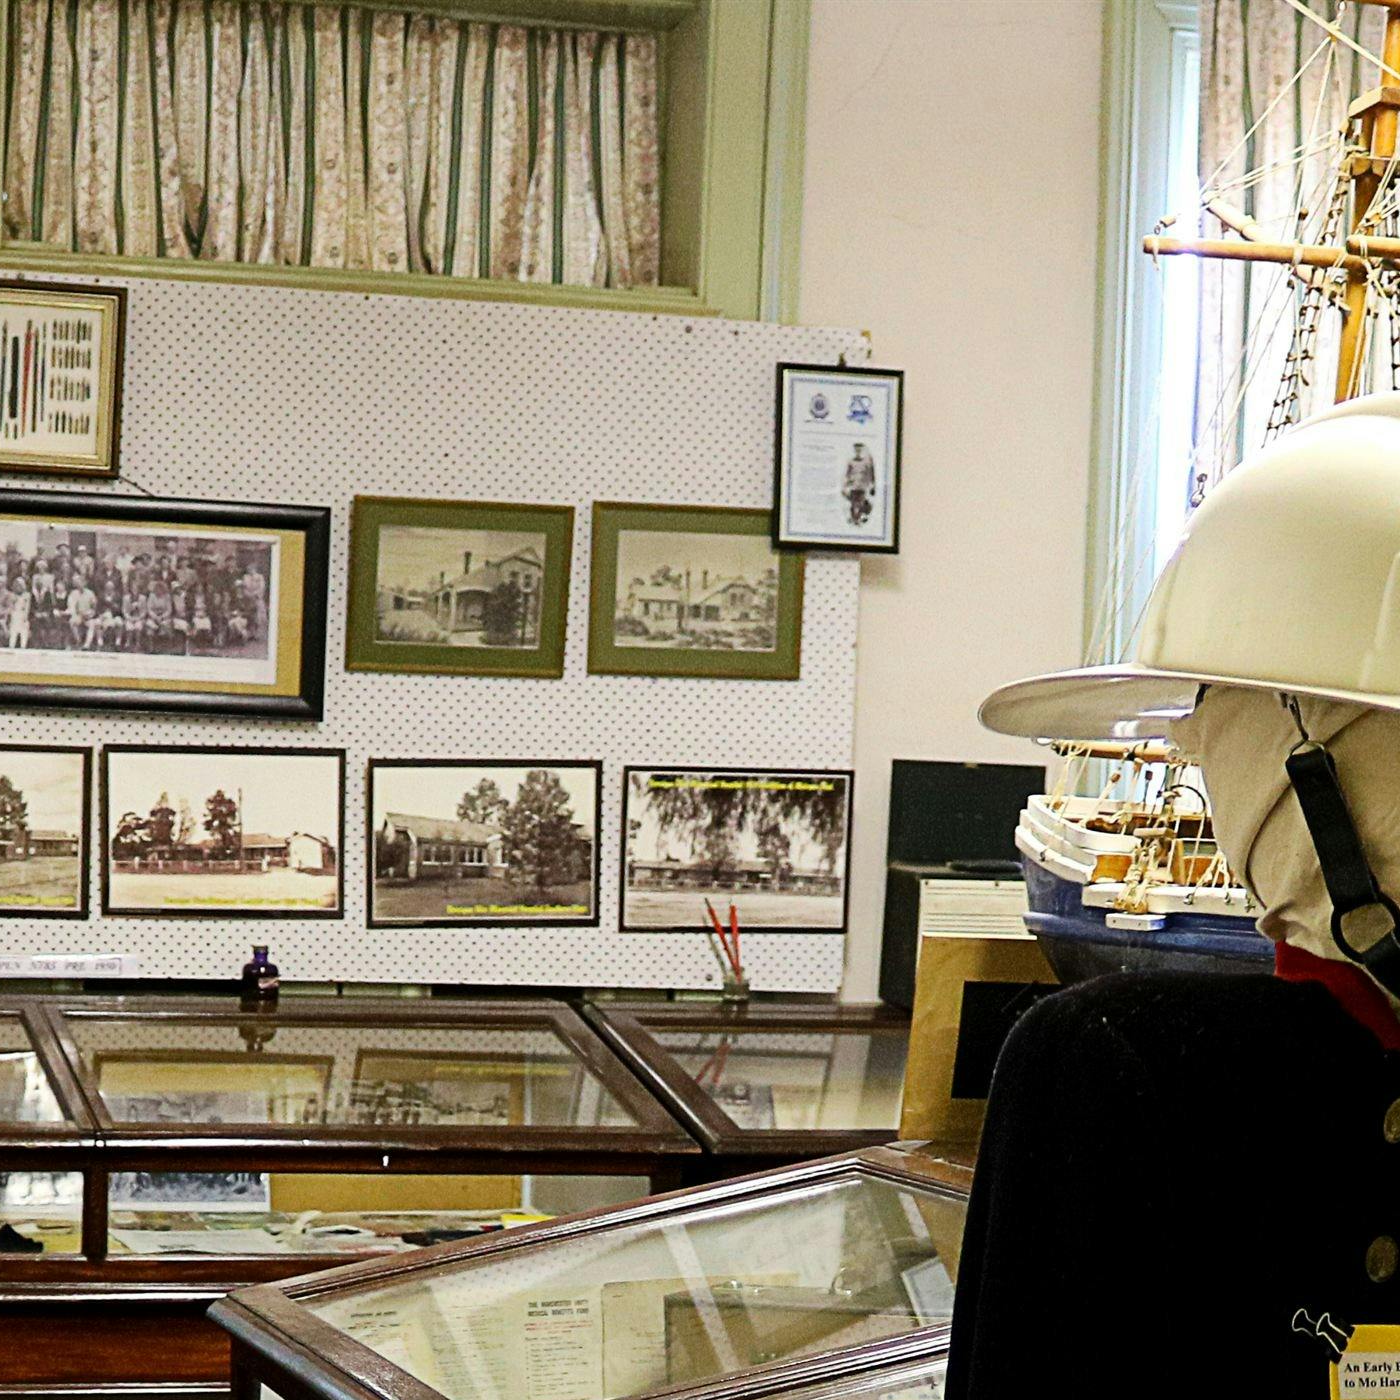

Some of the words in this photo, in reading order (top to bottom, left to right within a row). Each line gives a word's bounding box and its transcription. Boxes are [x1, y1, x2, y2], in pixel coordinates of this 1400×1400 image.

[1344, 1363, 1360, 1373] An
[1363, 1362, 1393, 1375] Early
[1344, 1378, 1355, 1388] to
[1359, 1377, 1377, 1388] Mo
